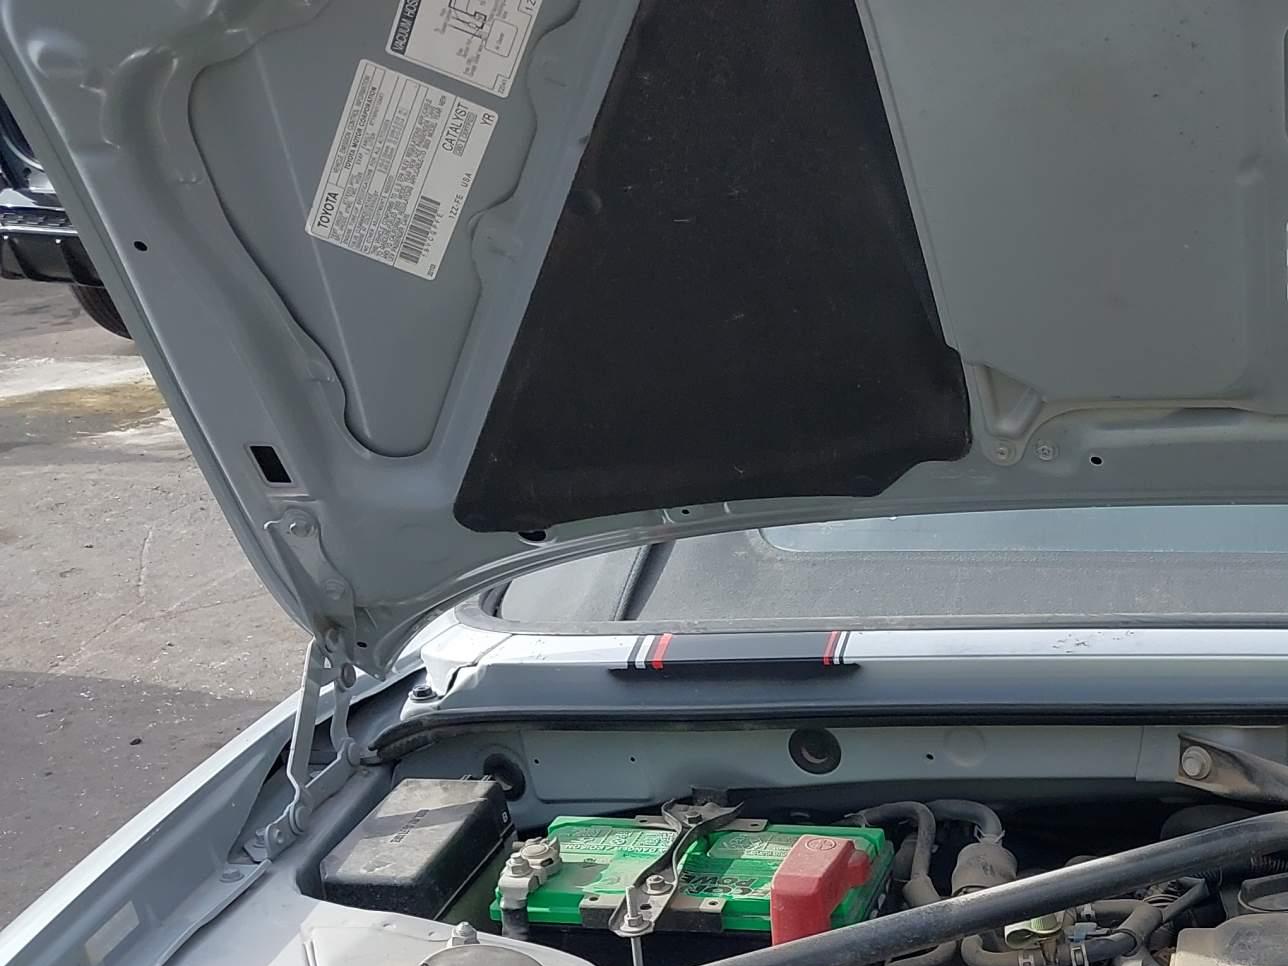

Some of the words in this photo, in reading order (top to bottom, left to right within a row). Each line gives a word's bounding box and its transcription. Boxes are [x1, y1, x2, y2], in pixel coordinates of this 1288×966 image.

[391, 17, 412, 52] VACUUM
[343, 147, 356, 170] TOYOTA
[351, 127, 363, 148] MOTOR
[358, 85, 377, 127] CORPORATION
[440, 100, 469, 153] CATALYST
[479, 111, 494, 128] YR
[316, 189, 339, 230] TOYOTA
[448, 193, 464, 220] 1ZZ-FE
[460, 170, 472, 188] USA
